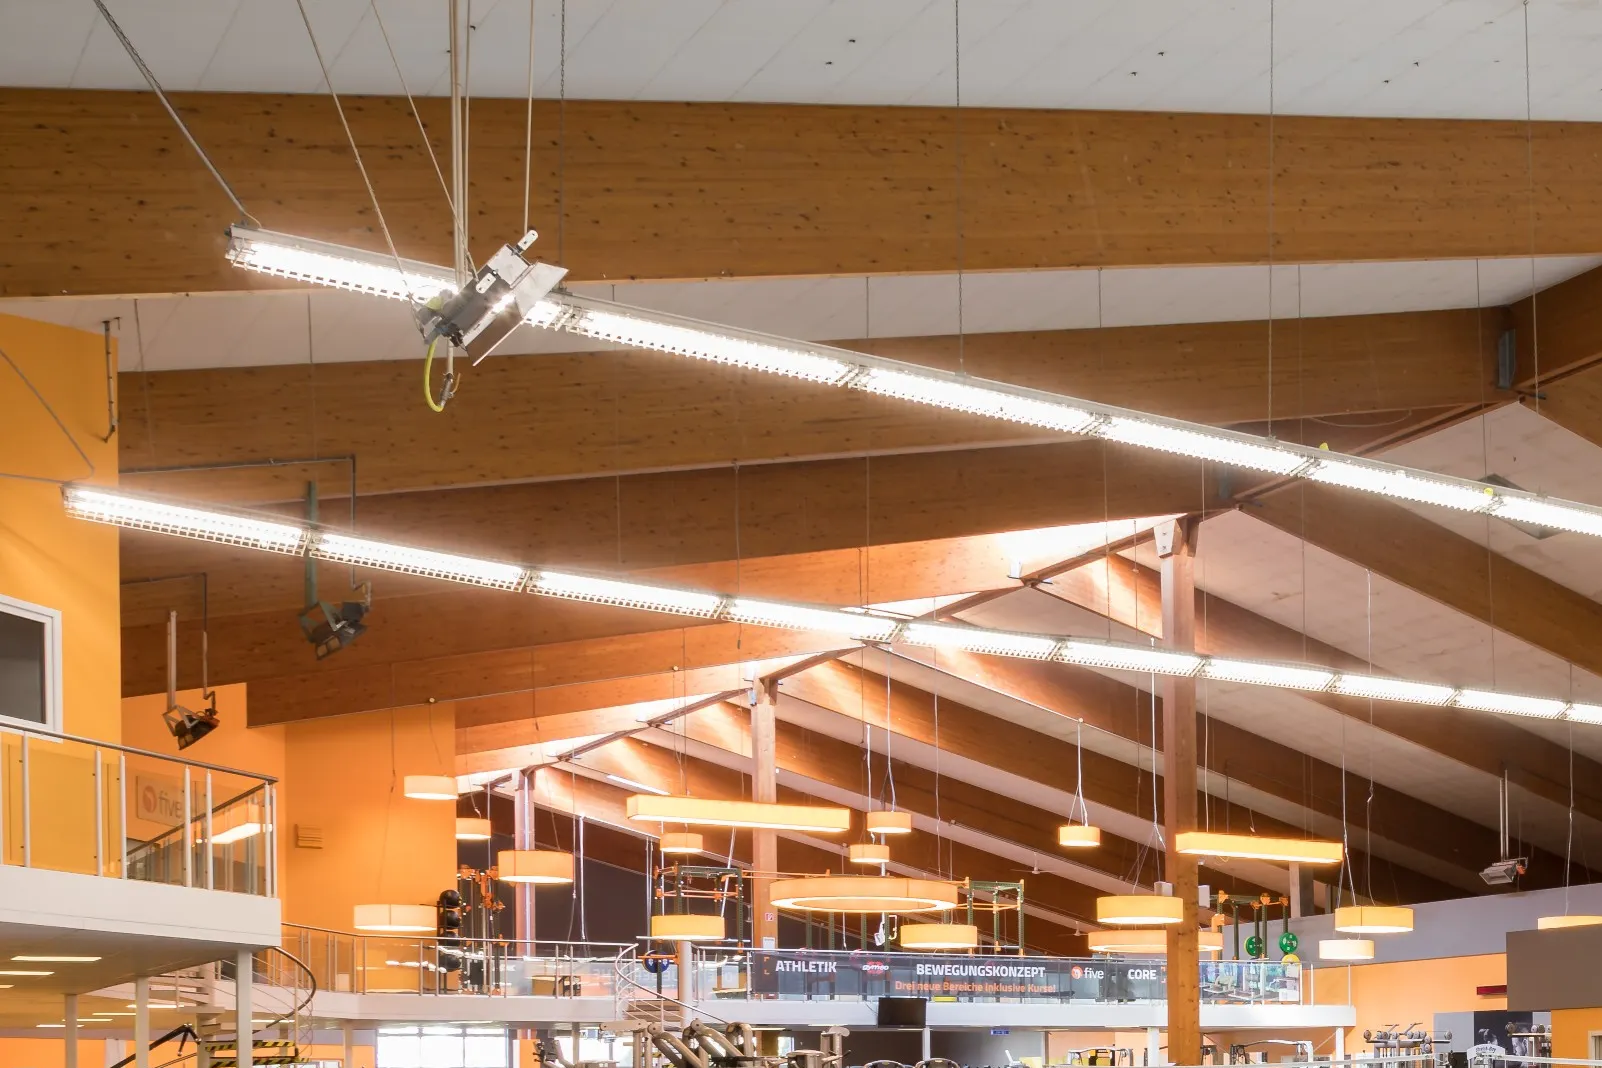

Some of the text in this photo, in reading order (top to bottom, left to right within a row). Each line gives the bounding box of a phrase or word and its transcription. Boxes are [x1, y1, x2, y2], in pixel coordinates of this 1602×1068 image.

[159, 789, 183, 819] five
[775, 960, 837, 973] ATHLETIK
[916, 963, 1046, 978] BEWEGUNGSKONZEPT
[1084, 967, 1105, 979] five
[1127, 968, 1157, 980] CORE
[895, 980, 916, 991] Drei
[917, 982, 941, 991] neue
[943, 981, 983, 992] Bereiche
[1028, 984, 1057, 993] Kurse!
